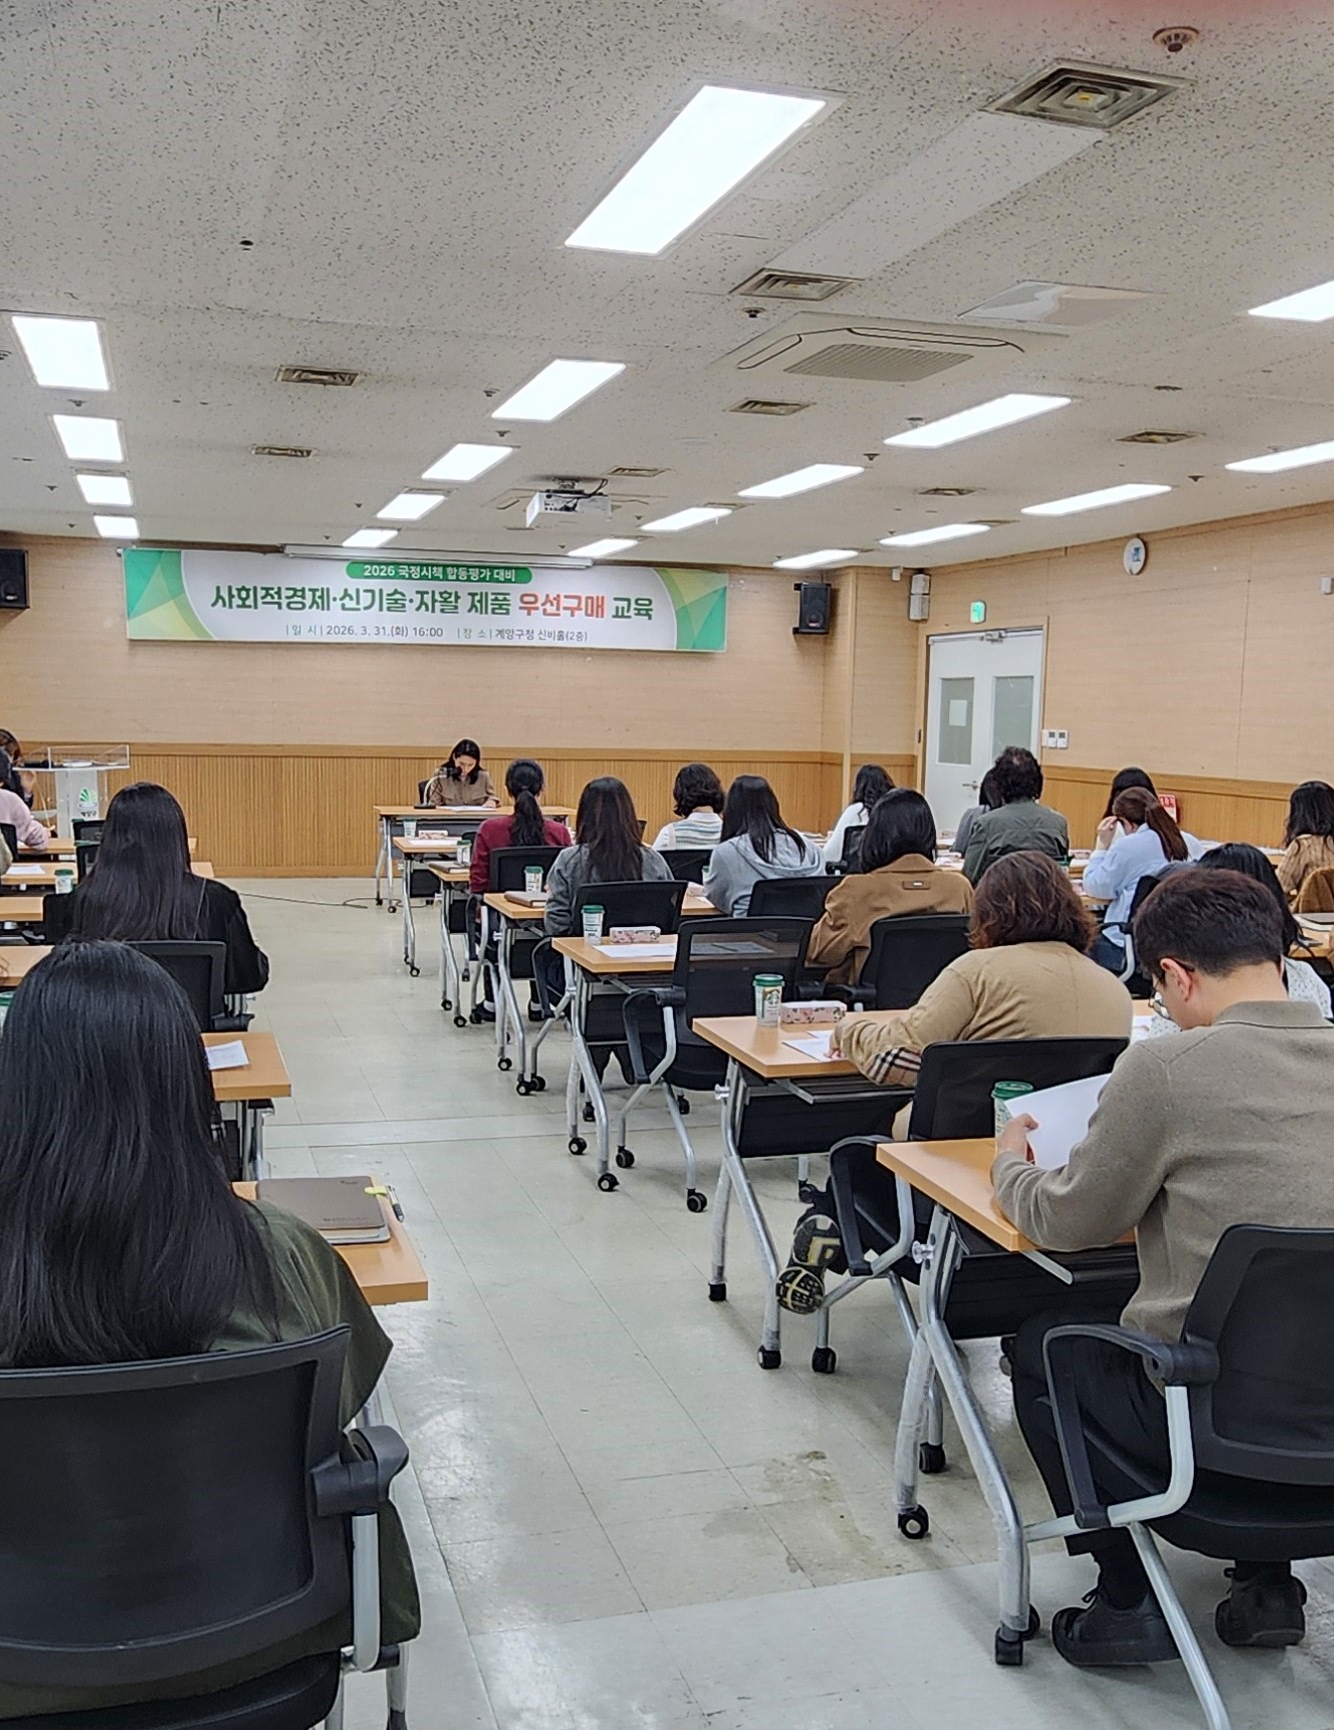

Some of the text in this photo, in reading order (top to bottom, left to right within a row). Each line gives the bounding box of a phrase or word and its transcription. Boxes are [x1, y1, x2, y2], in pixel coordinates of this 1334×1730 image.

[363, 564, 516, 582] 2026 국정시책 합동평가 대비
[210, 585, 654, 621] 사회적경제·신기술·자활 제품 우선구매 교육
[326, 625, 358, 636] 2026.
[360, 625, 371, 637] 3.
[375, 625, 409, 638] 31.(화)
[412, 627, 444, 638] 16:00
[495, 628, 535, 641] 계양구청
